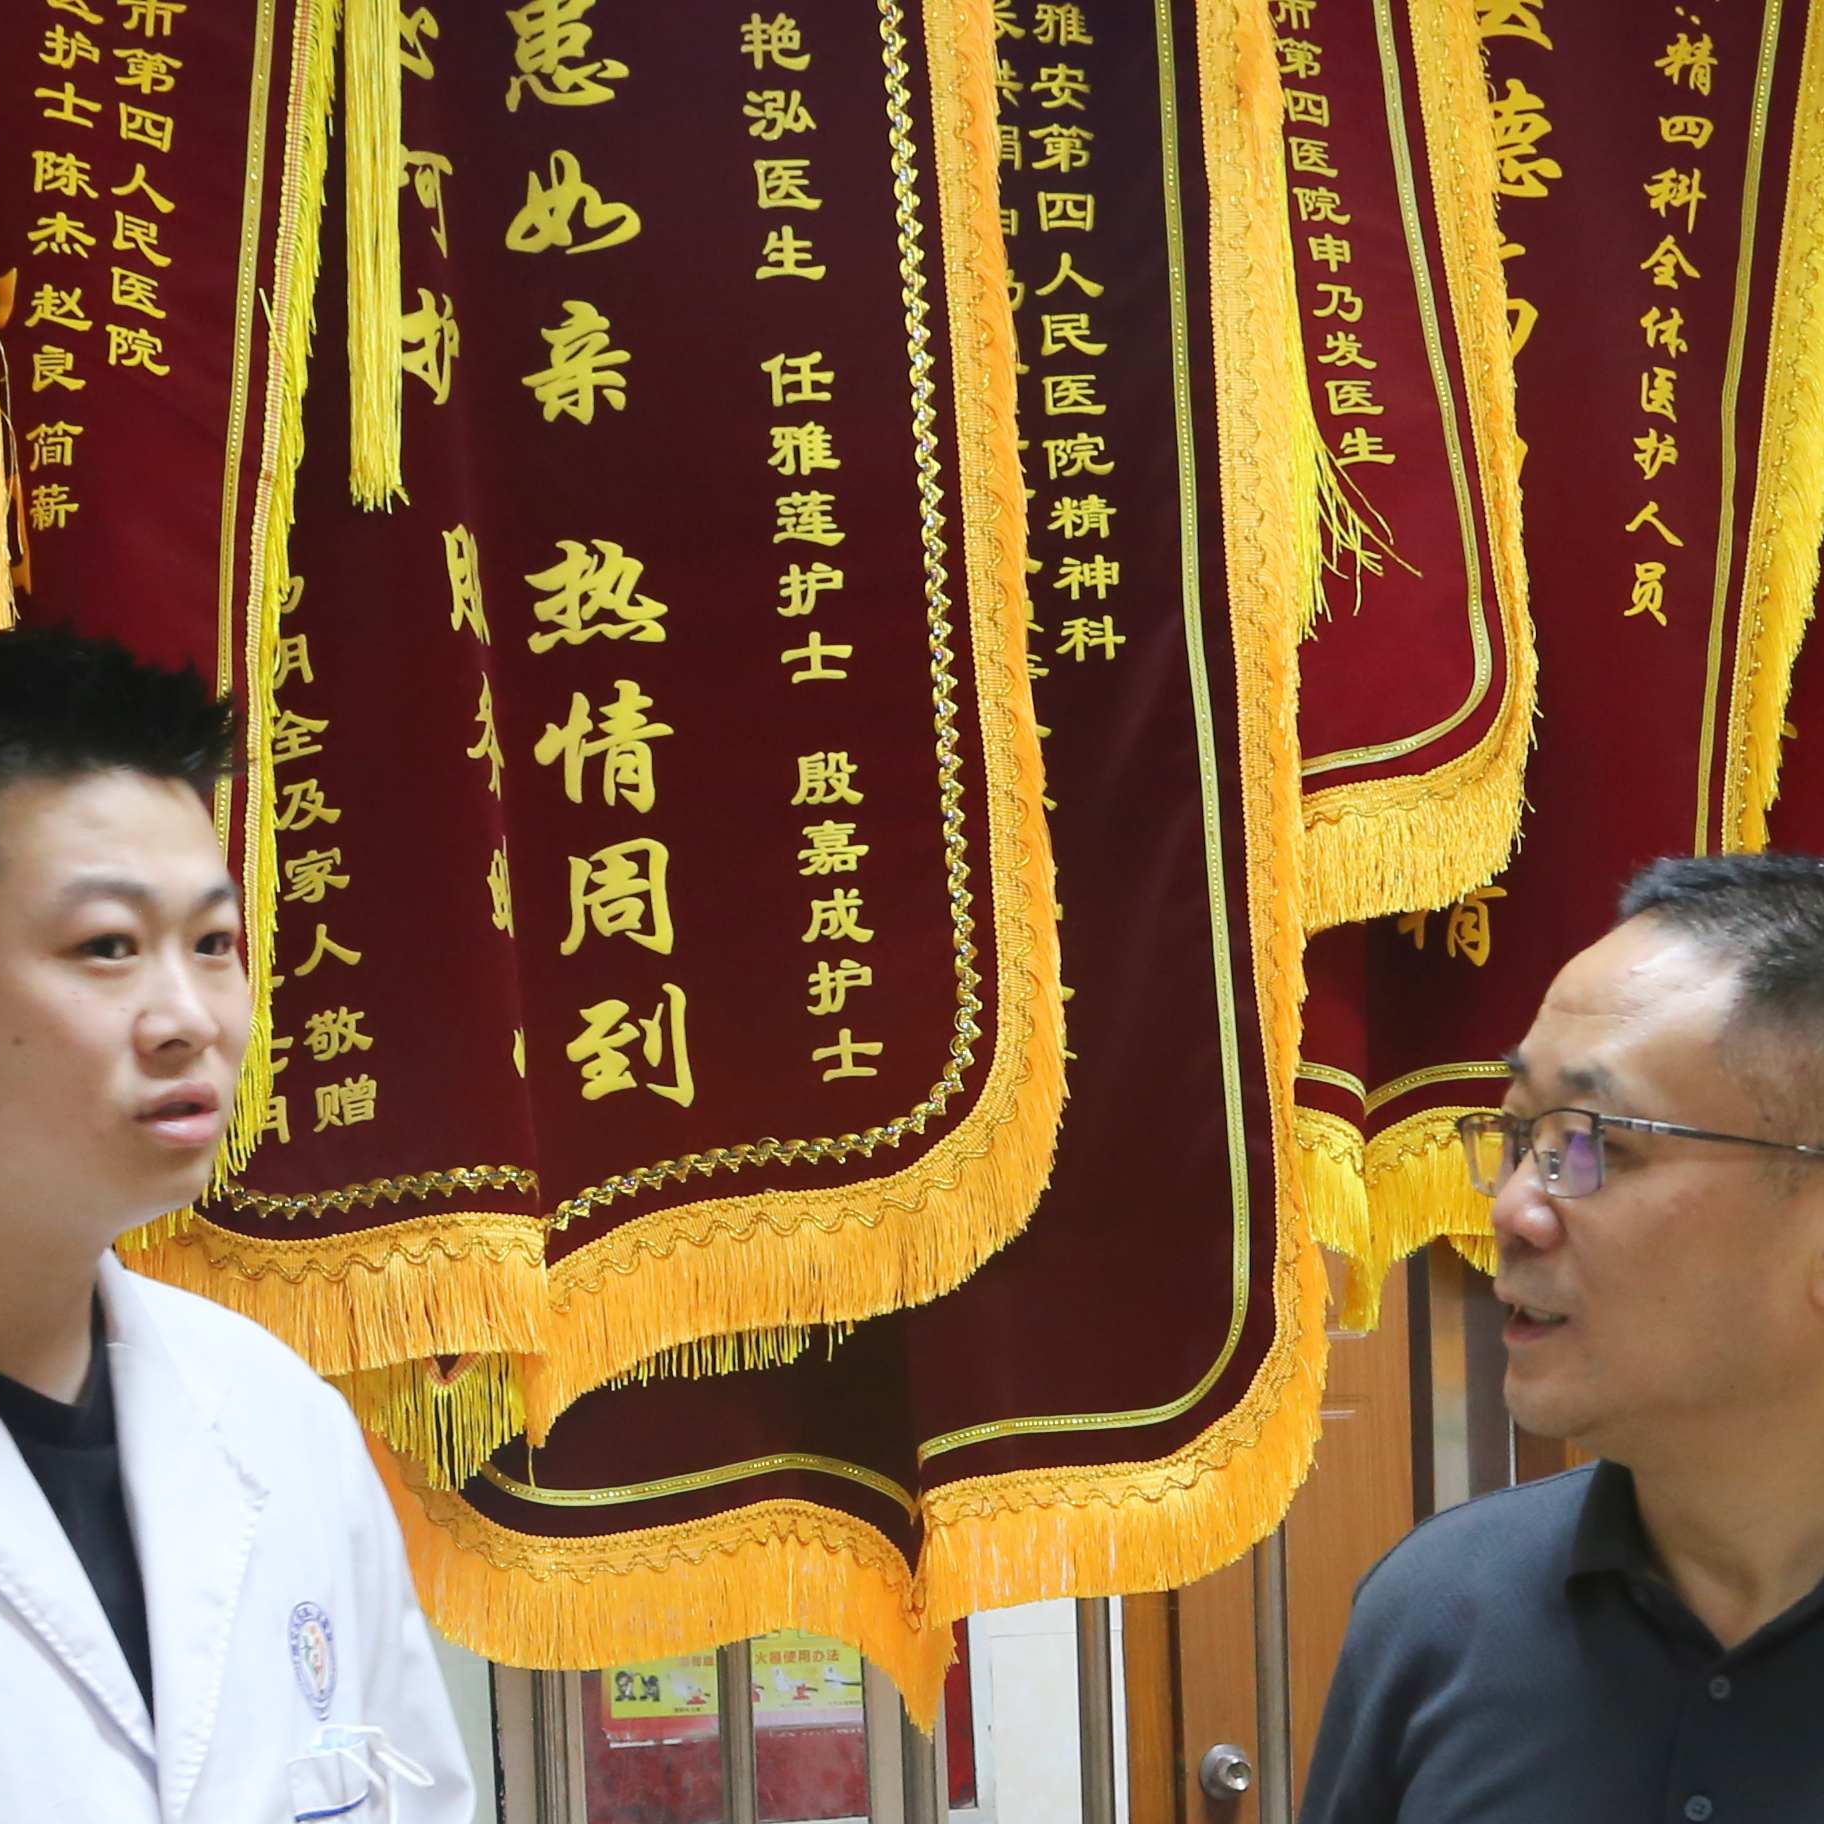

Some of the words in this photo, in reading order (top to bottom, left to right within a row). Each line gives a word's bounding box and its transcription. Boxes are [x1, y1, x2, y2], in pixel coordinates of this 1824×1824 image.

[760, 351, 853, 684] 任雅莲护士
[1030, 3, 1126, 662] 雅安第四人民医院精神科
[524, 539, 695, 1108] 热情周到
[790, 751, 883, 1082] 殷嘉成护士
